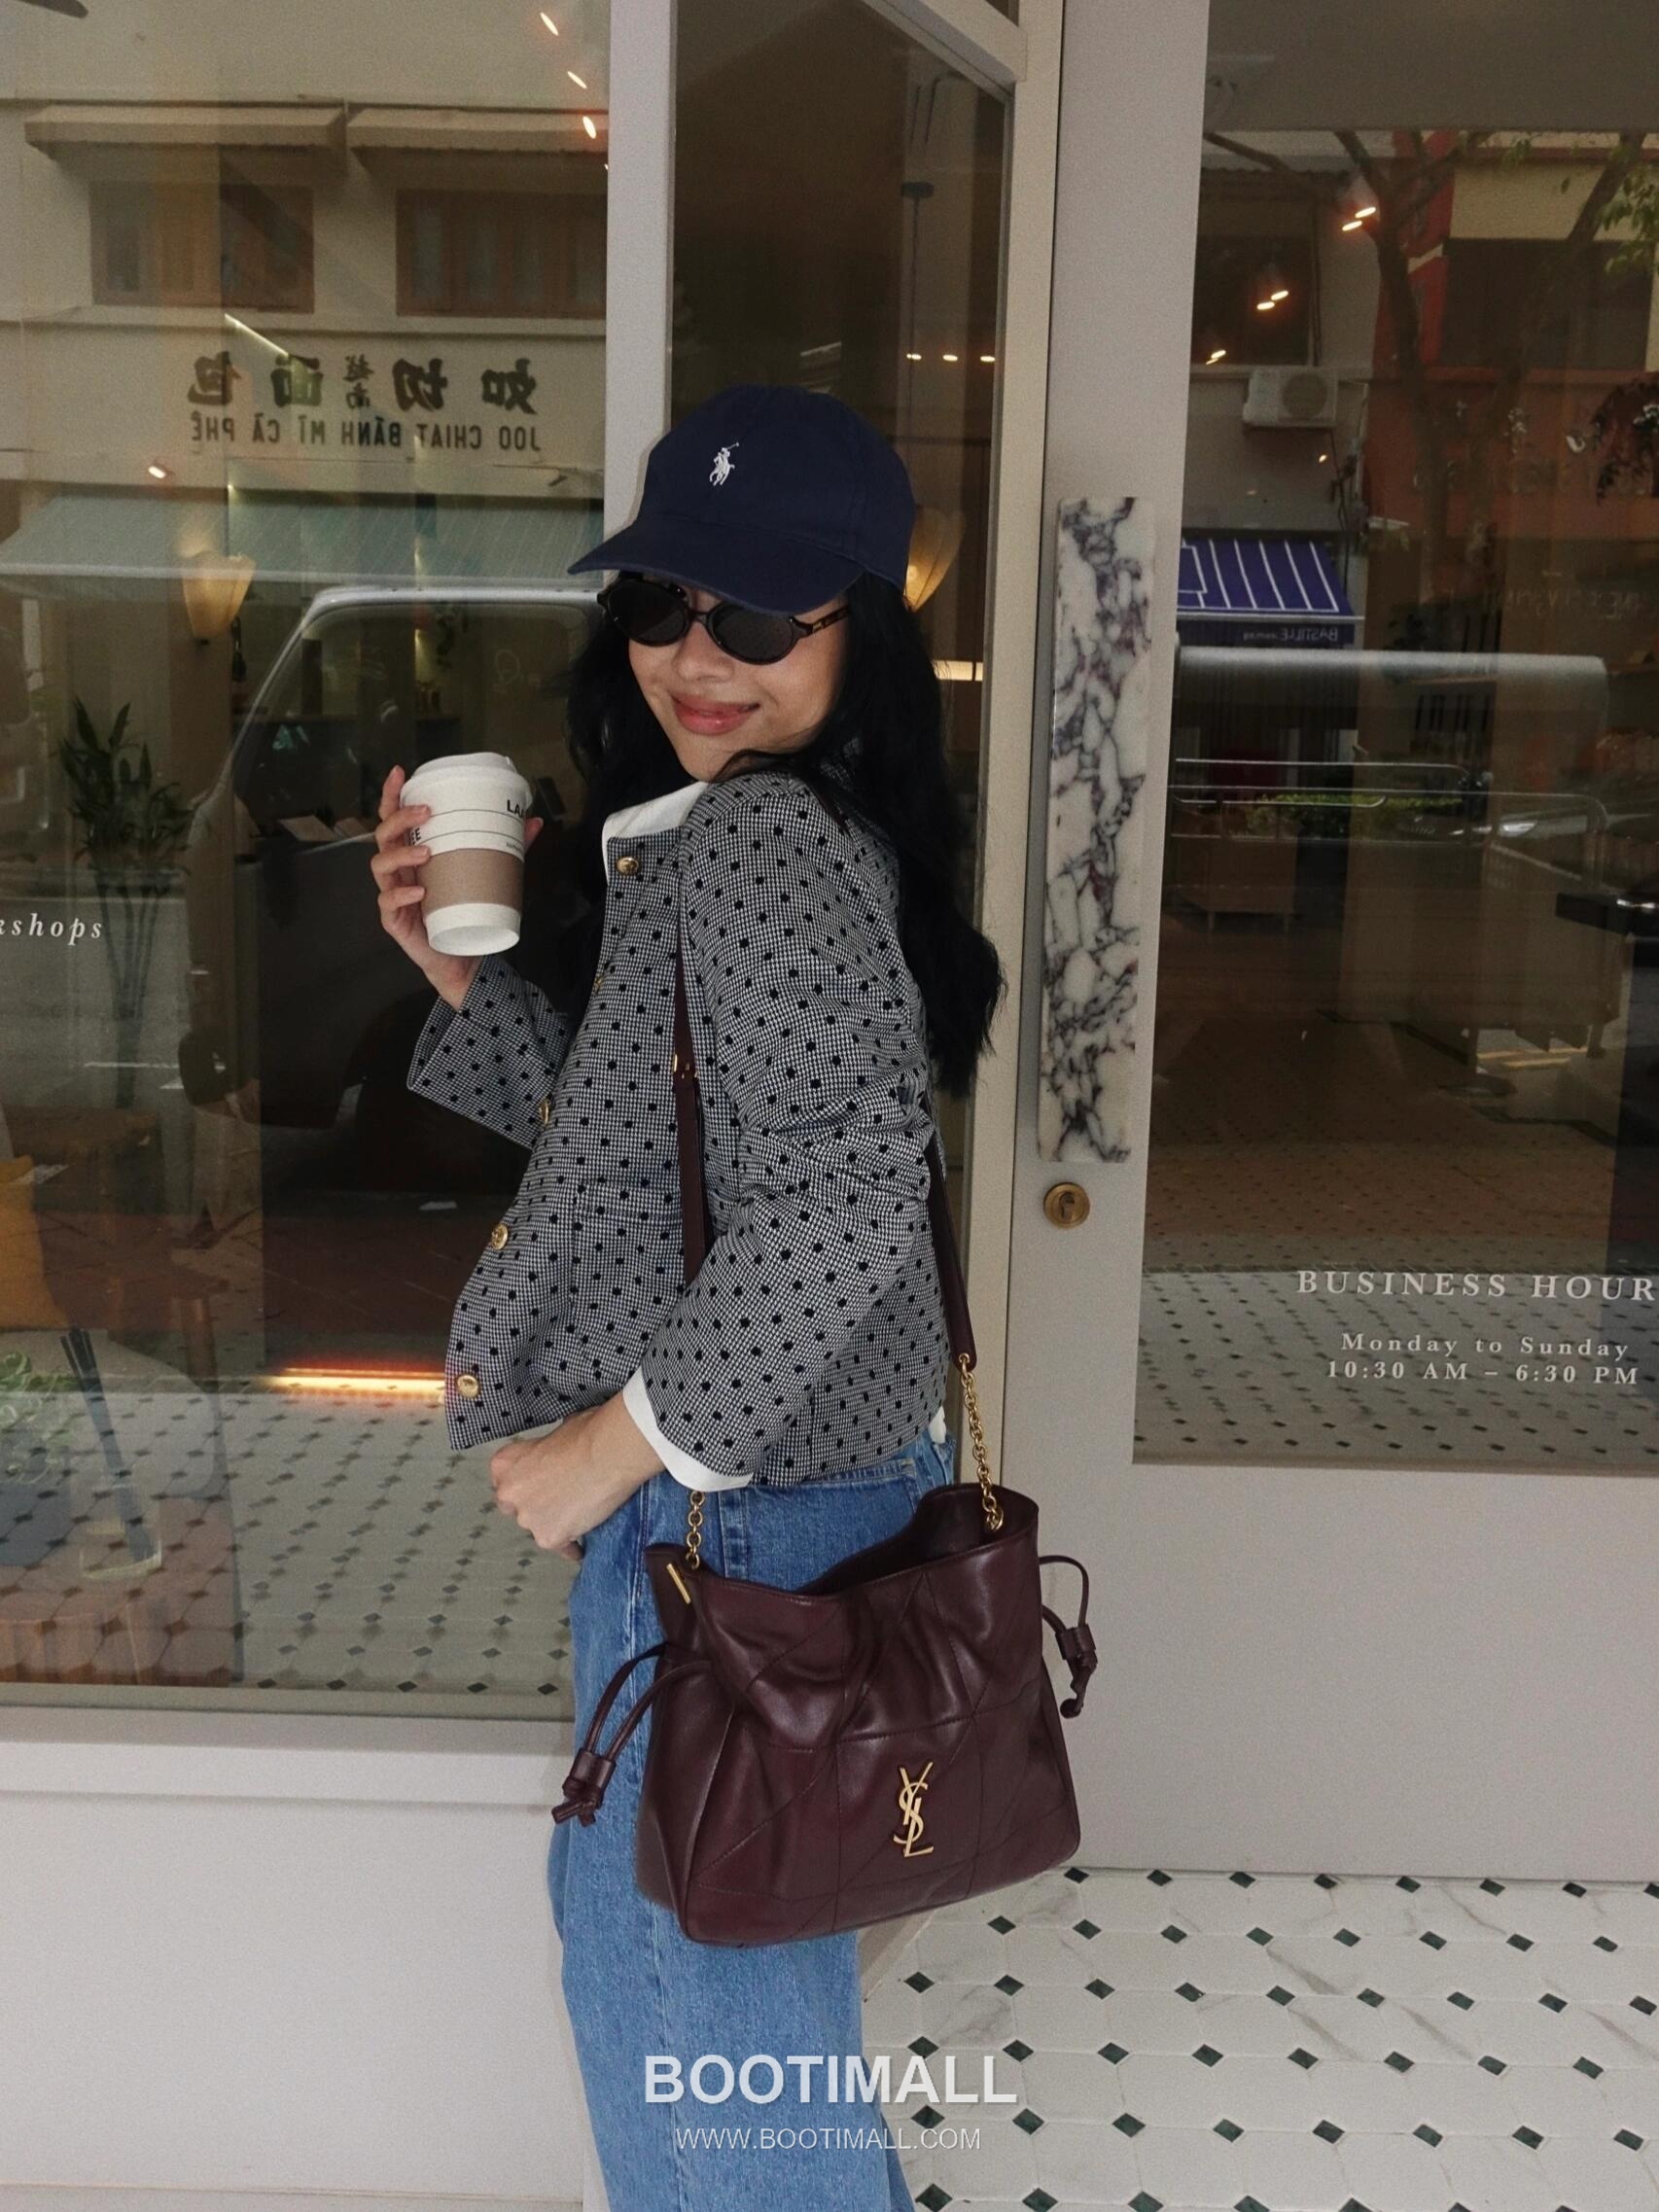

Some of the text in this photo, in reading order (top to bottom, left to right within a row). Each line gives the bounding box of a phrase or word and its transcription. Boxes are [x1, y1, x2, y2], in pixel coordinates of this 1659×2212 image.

[1296, 1270, 1655, 1301] BUSINESS HOUR
[1341, 1333, 1629, 1361] Monday to Sunday
[1327, 1360, 1405, 1379] 10:30
[1422, 1362, 1468, 1381] AM
[1515, 1364, 1577, 1383] 6:30
[1593, 1367, 1639, 1386] PM
[893, 1761, 935, 1858] YSL
